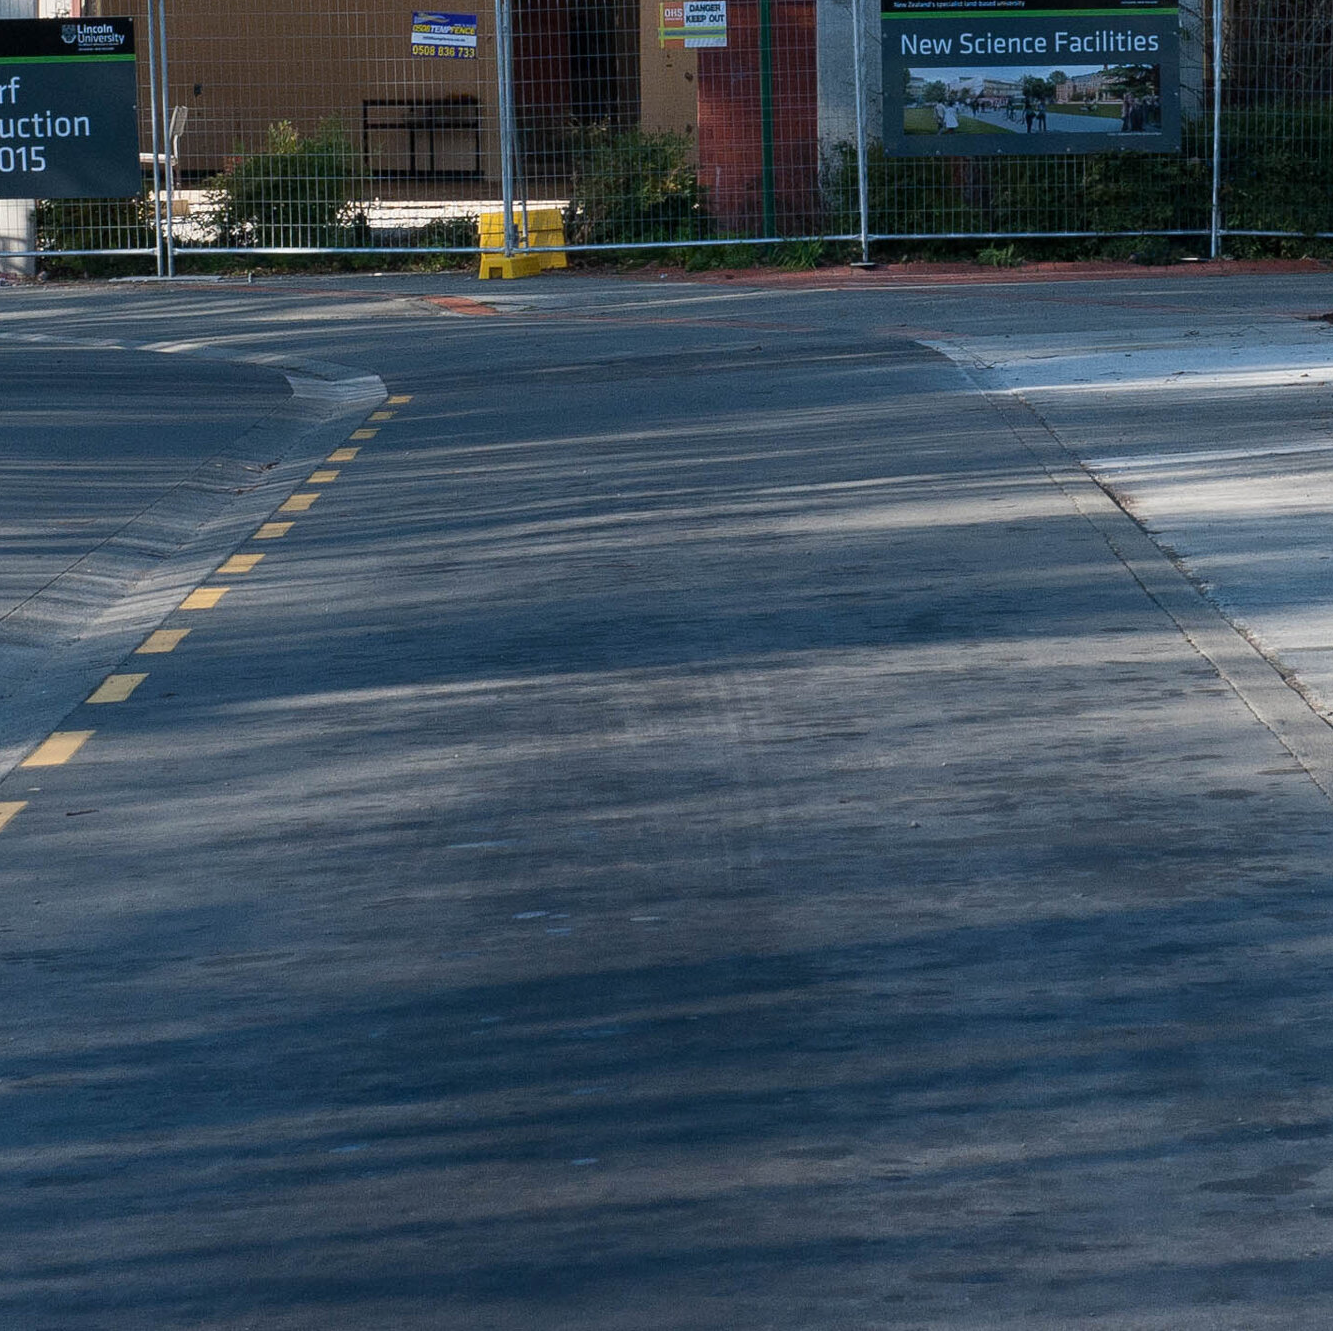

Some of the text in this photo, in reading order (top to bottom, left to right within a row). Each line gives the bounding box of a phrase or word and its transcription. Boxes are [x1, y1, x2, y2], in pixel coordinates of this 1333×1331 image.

[665, 8, 683, 17] OHS
[689, 4, 721, 12] DANGER
[686, 15, 707, 23] KEEP
[709, 14, 725, 22] OUT
[77, 24, 113, 34] Lincoln
[77, 33, 125, 44] University
[901, 30, 1159, 55] New Science Facilities
[412, 45, 475, 58] 0508 836 733
